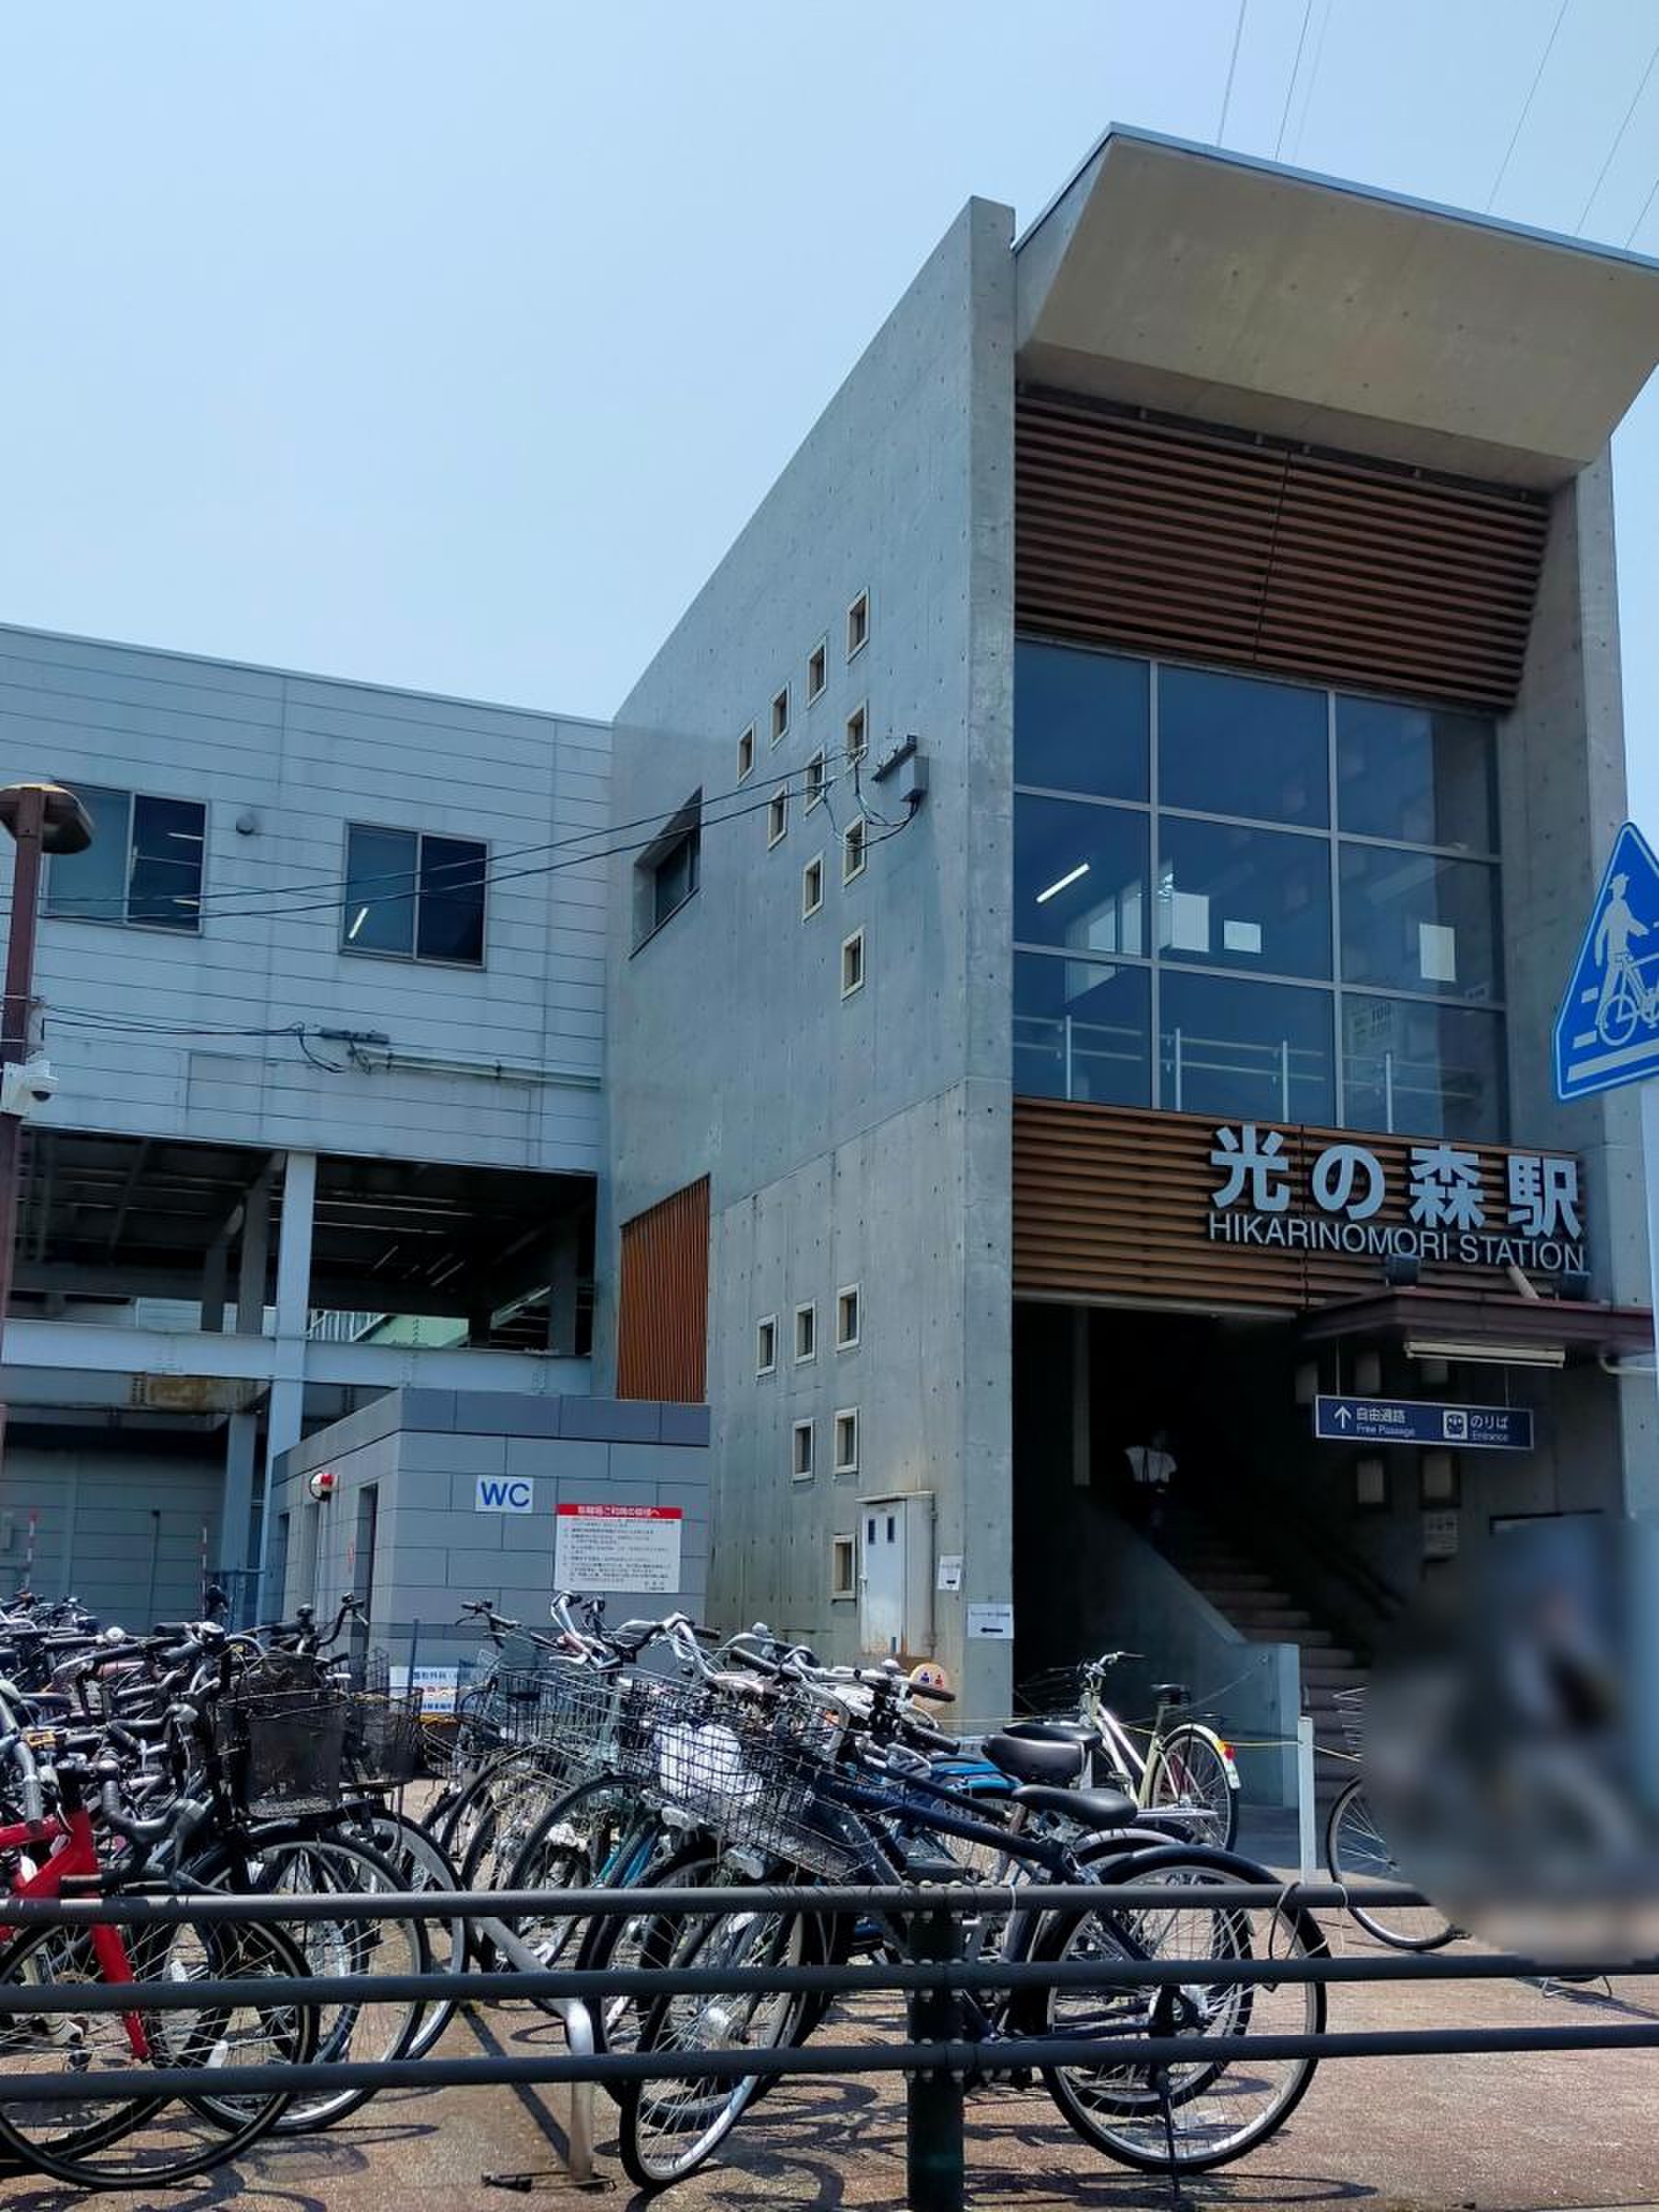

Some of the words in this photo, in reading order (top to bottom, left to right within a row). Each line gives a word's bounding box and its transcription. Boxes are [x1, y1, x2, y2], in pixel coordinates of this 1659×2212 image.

[1210, 1124, 1583, 1240] 光の森駅
[1208, 1211, 1448, 1261] HIKARINOMORI
[1459, 1235, 1584, 1271] STATION
[1356, 1406, 1406, 1424] 自由通路
[1470, 1415, 1510, 1430] のりば
[1356, 1423, 1376, 1434] Free
[1378, 1425, 1416, 1438] Passage
[1472, 1430, 1510, 1442] Entrance
[480, 1481, 531, 1508] WC
